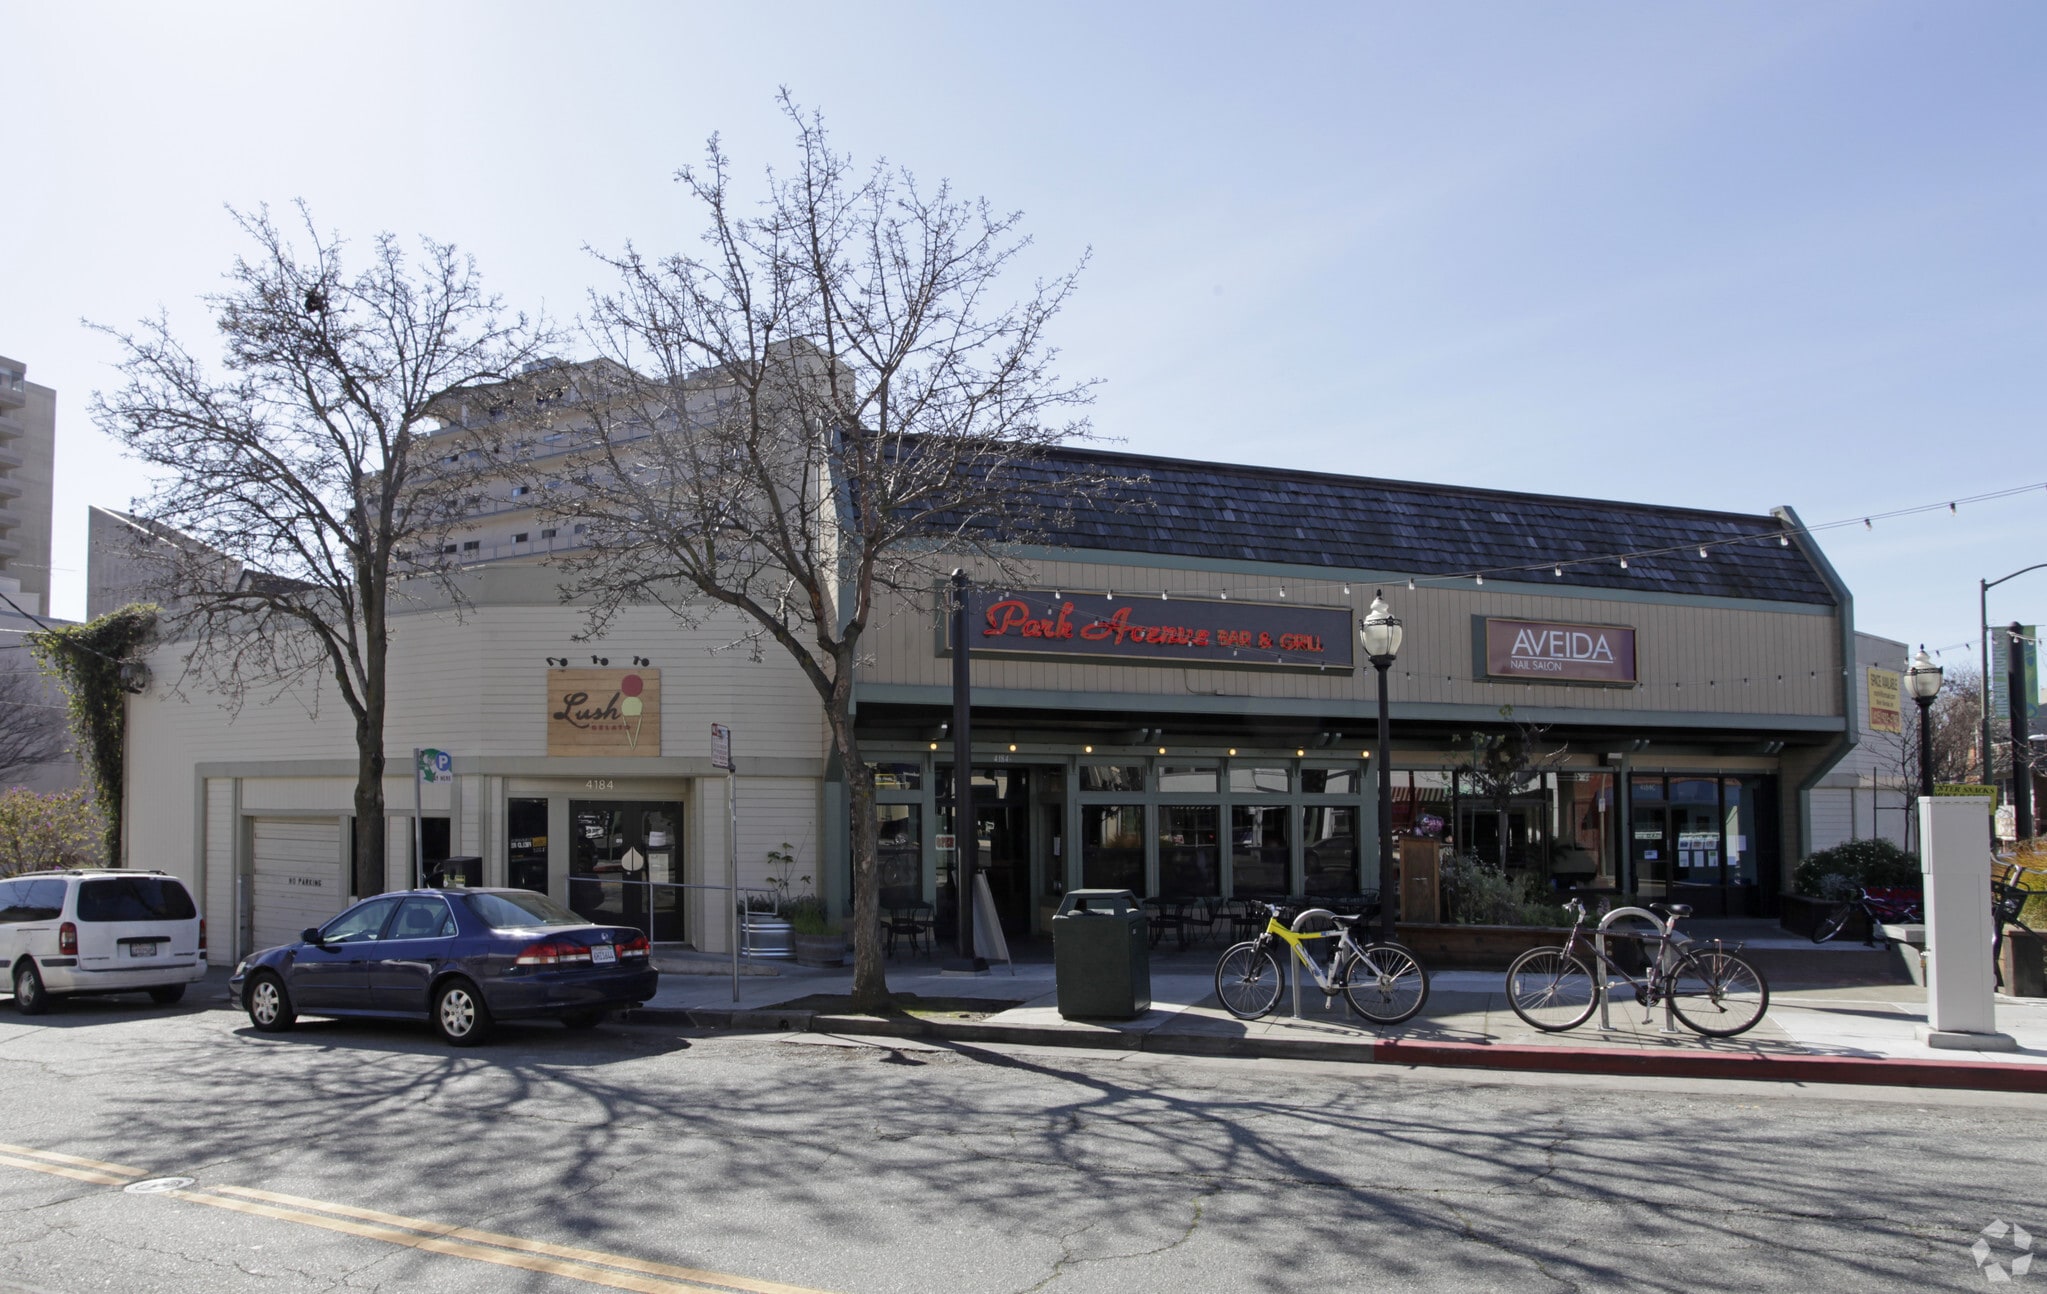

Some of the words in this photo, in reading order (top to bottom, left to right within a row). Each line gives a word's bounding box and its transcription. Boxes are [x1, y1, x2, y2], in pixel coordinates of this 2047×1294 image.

[984, 600, 1073, 638] Park
[1080, 607, 1211, 645] Avenue
[1217, 629, 1252, 647] BAR
[1258, 631, 1273, 648] &
[1279, 632, 1324, 651] GRILL
[1511, 628, 1614, 661] AVEIDA
[1511, 660, 1530, 670] NAIL
[1533, 661, 1562, 671] SALON
[553, 692, 621, 729] Lush
[438, 754, 449, 769] P
[585, 779, 614, 790] 4184
[288, 877, 296, 885] NO
[299, 877, 321, 887] PARKING
